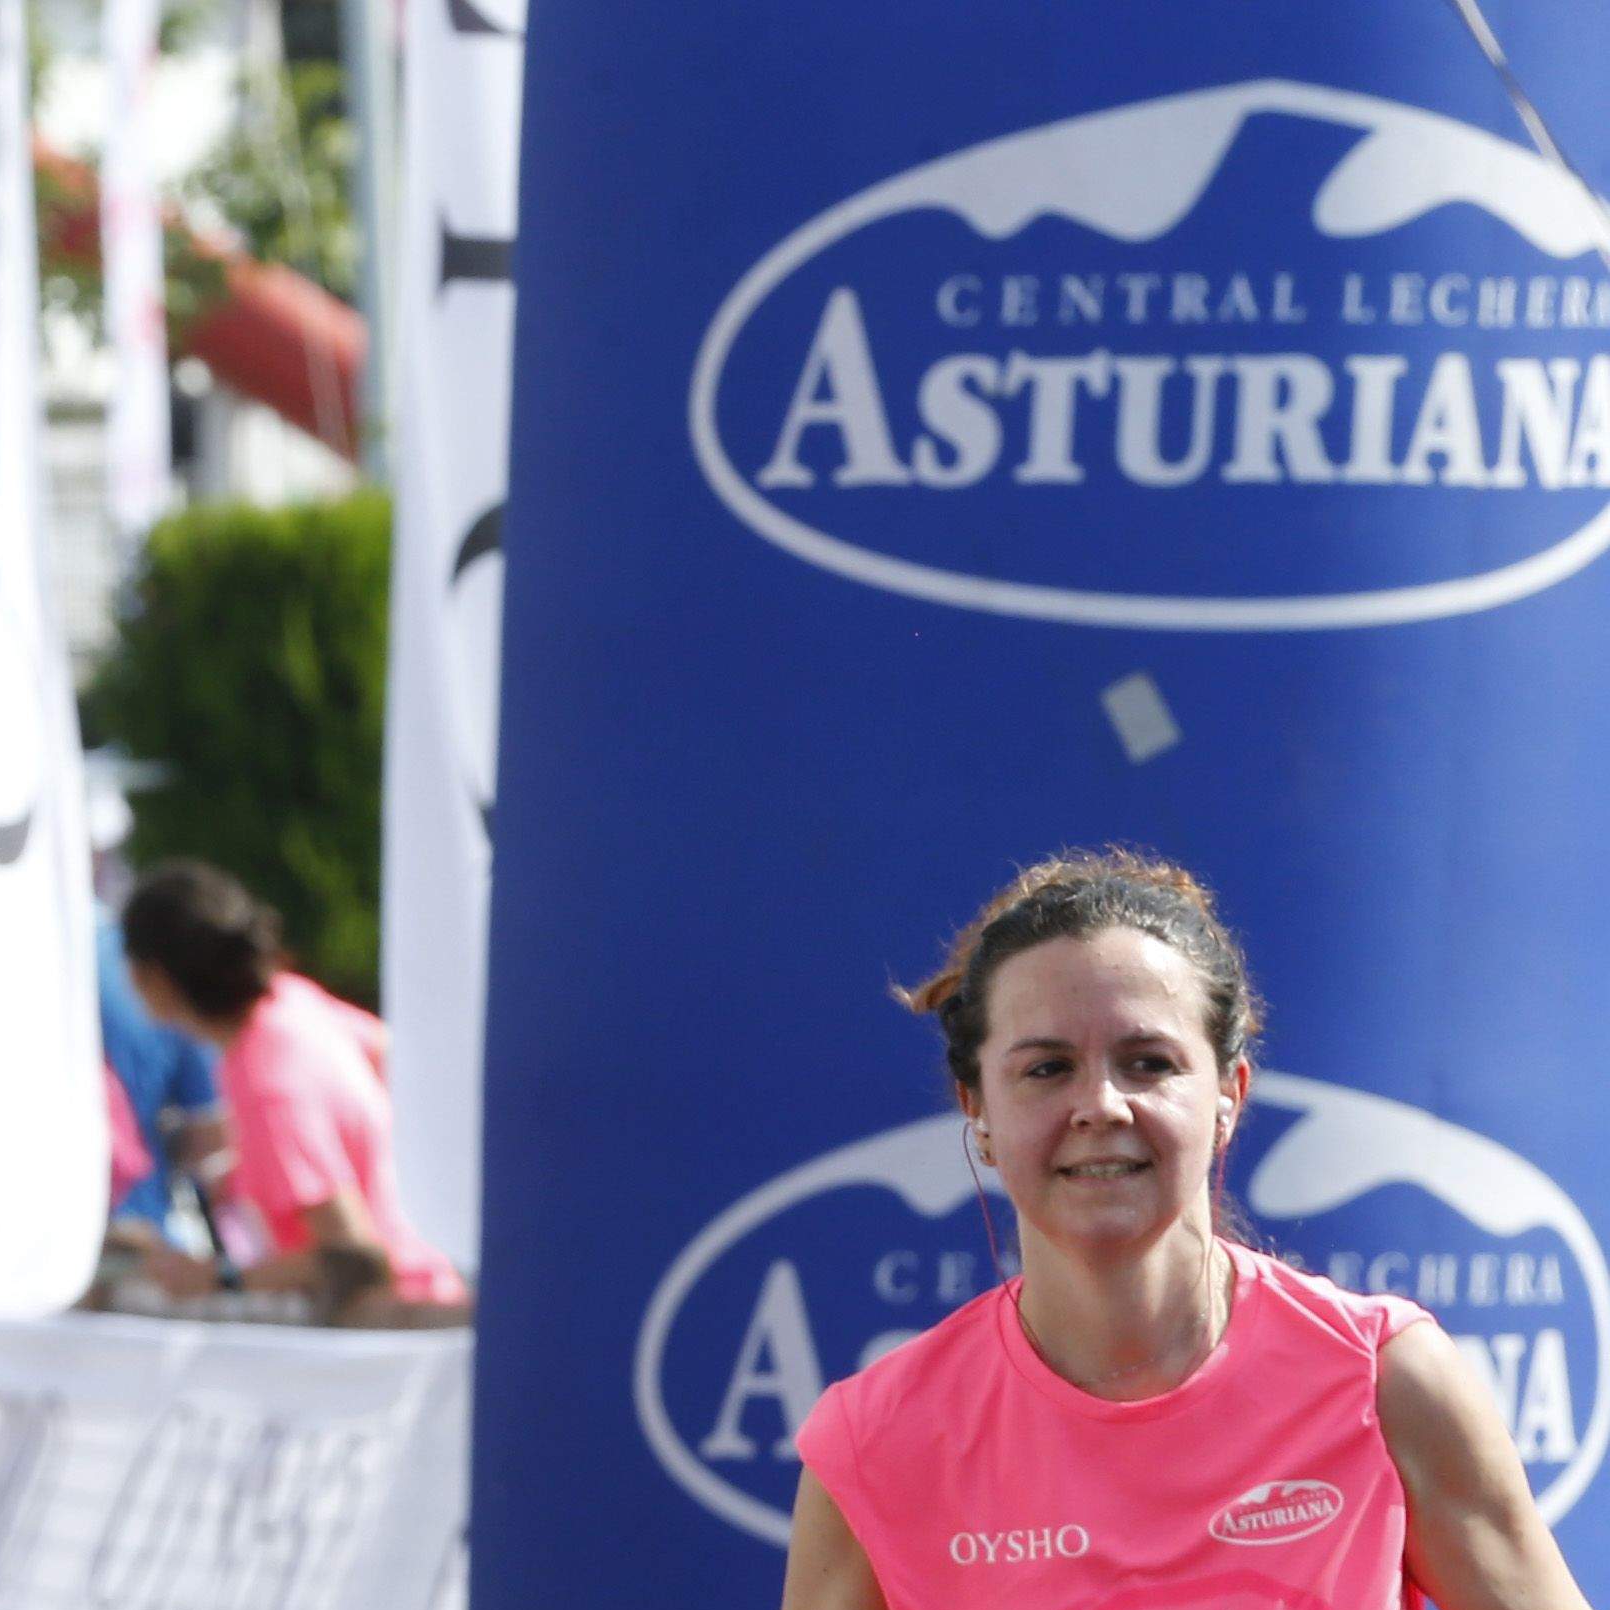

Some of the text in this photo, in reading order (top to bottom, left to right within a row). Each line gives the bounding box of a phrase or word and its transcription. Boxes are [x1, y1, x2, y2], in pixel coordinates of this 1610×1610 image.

[935, 272, 1308, 328] CENTRAL
[949, 1524, 1091, 1566] OYSHO
[1222, 1497, 1336, 1536] ASTURIANA
